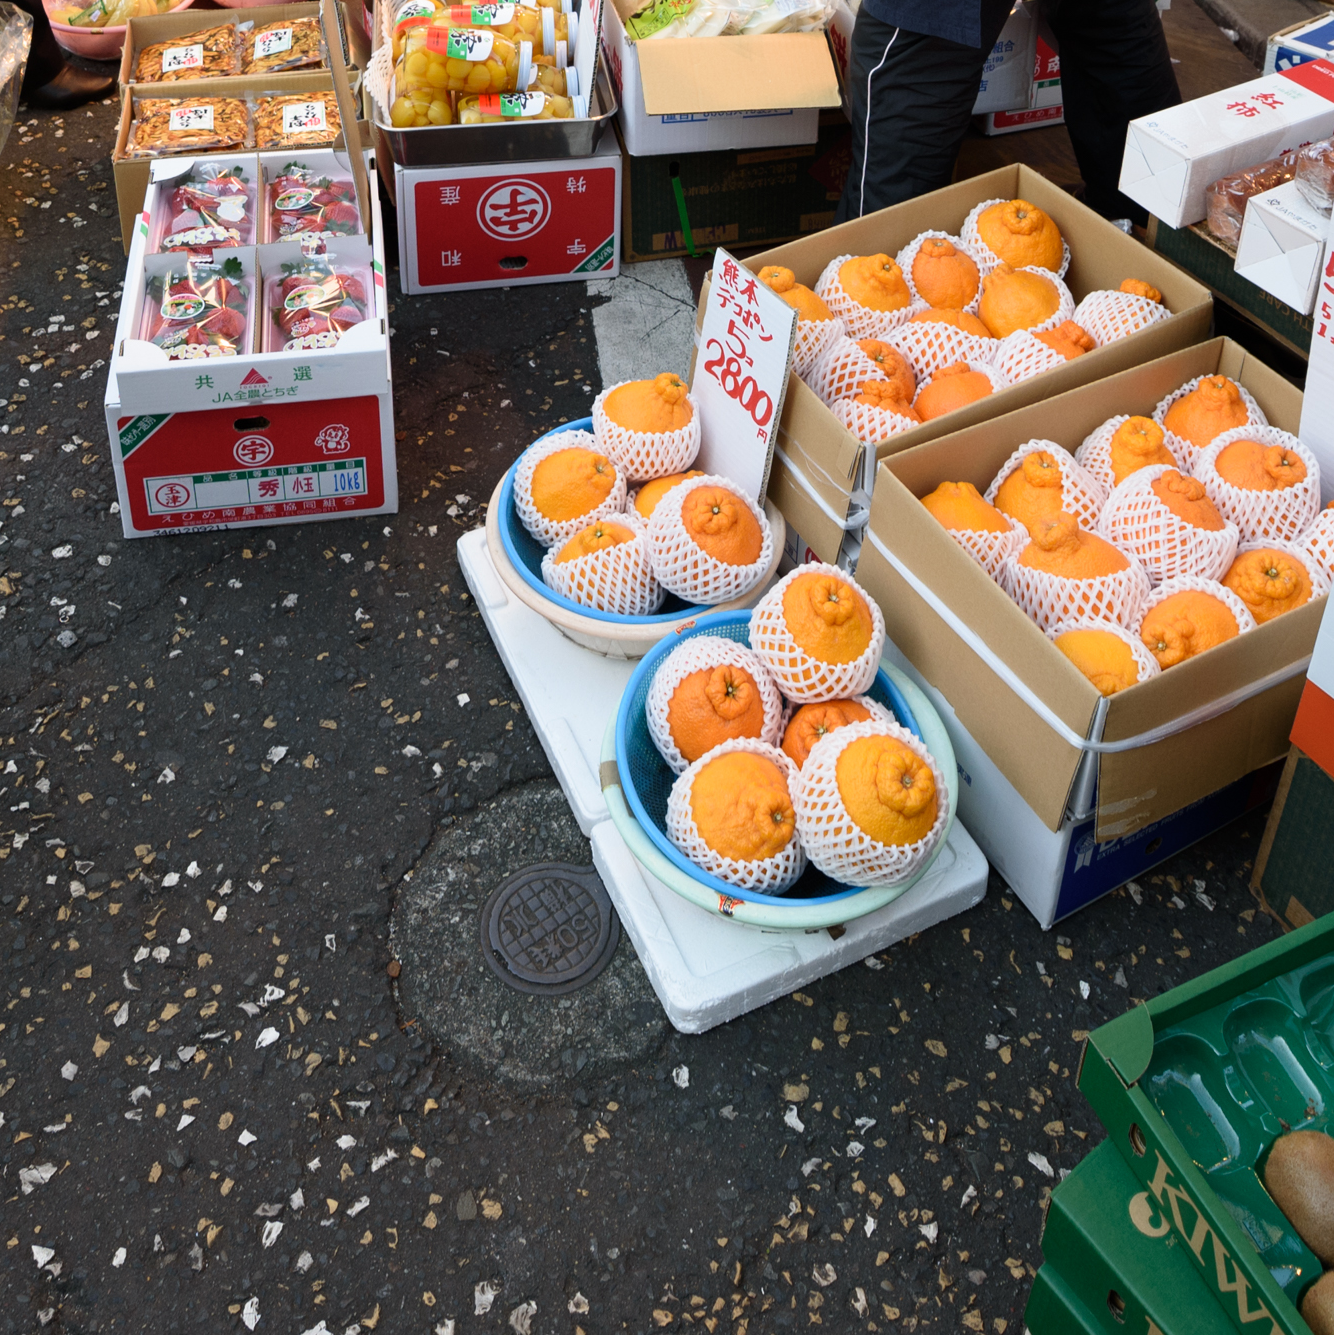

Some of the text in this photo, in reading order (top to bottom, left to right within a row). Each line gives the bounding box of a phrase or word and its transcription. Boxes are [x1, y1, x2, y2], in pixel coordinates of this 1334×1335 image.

[1226, 91, 1284, 119] 紅柿
[439, 176, 587, 205] 特 産
[441, 238, 587, 267] 宇 和
[718, 258, 760, 308] 熊本
[716, 286, 774, 343] デコポン
[195, 365, 313, 390] 共 選
[211, 385, 299, 404] JA全農とちぎ
[257, 471, 361, 498] 秀 小玉 10kg
[161, 496, 357, 524] えひめ南農業協同組合
[1096, 844, 1121, 861] EXTRA
[1123, 823, 1159, 847] SELECTED
